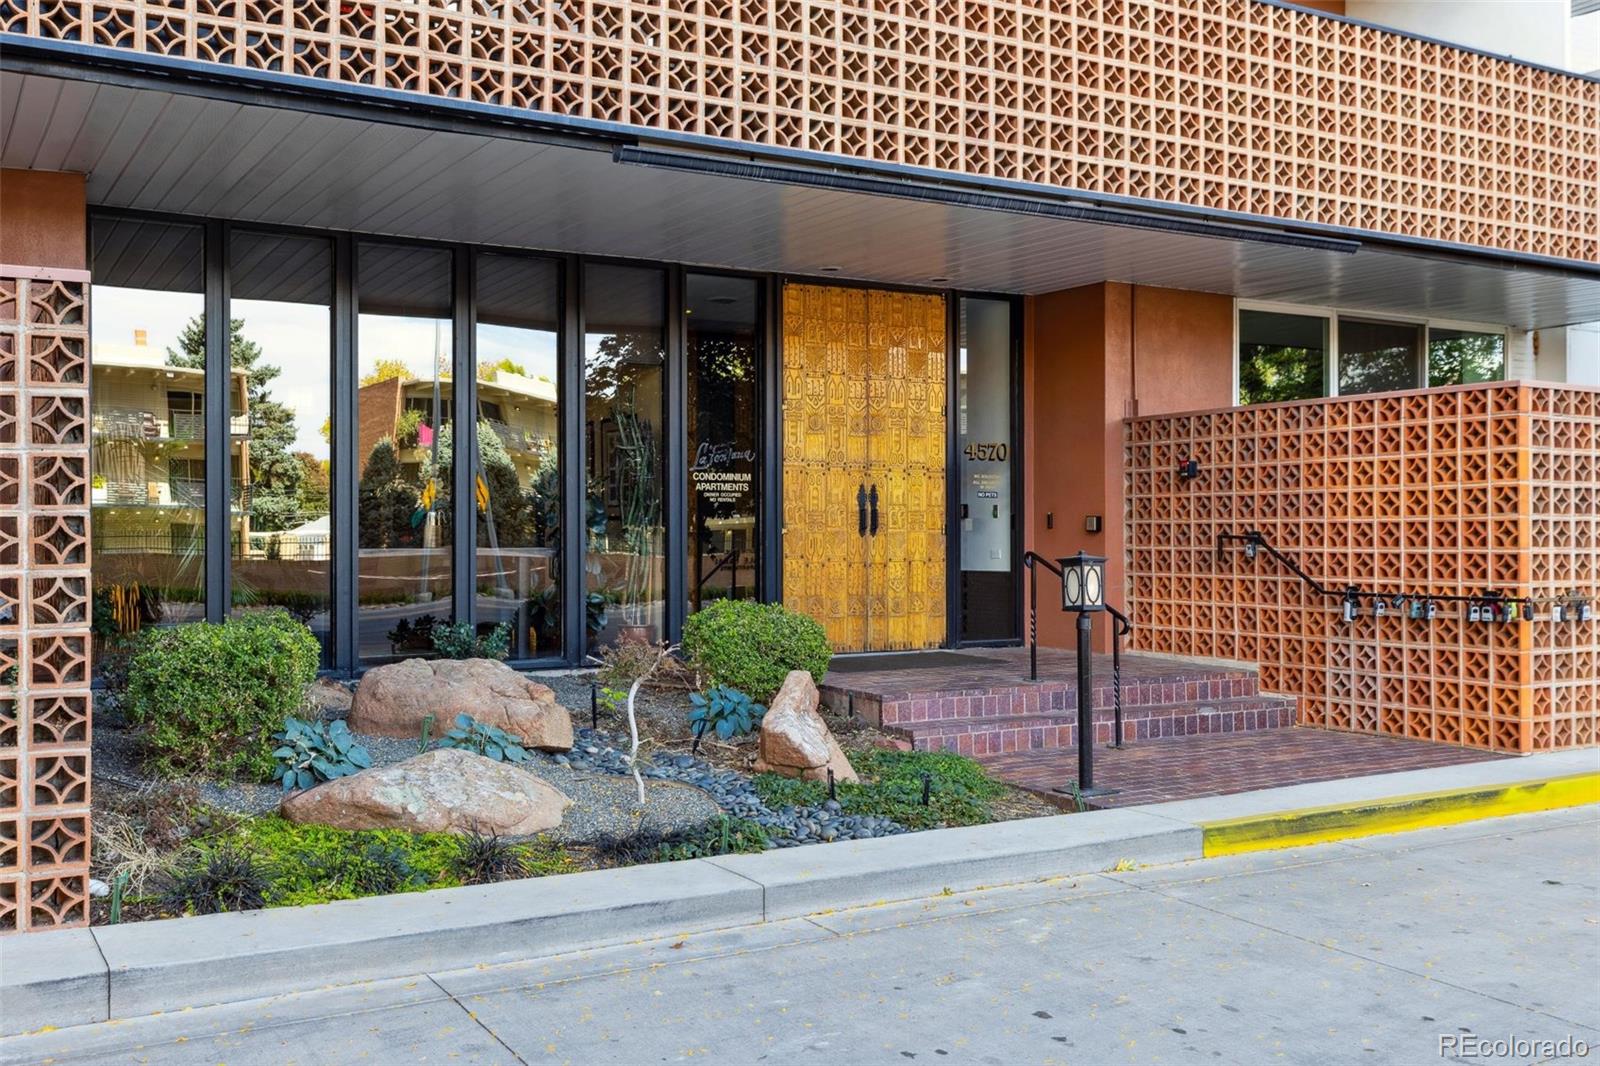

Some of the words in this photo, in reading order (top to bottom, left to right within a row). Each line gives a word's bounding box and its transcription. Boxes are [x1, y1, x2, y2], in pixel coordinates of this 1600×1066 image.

[963, 443, 1007, 461] 4570
[692, 472, 752, 481] CONDOMINIUM
[695, 482, 749, 491] APARTMENTS
